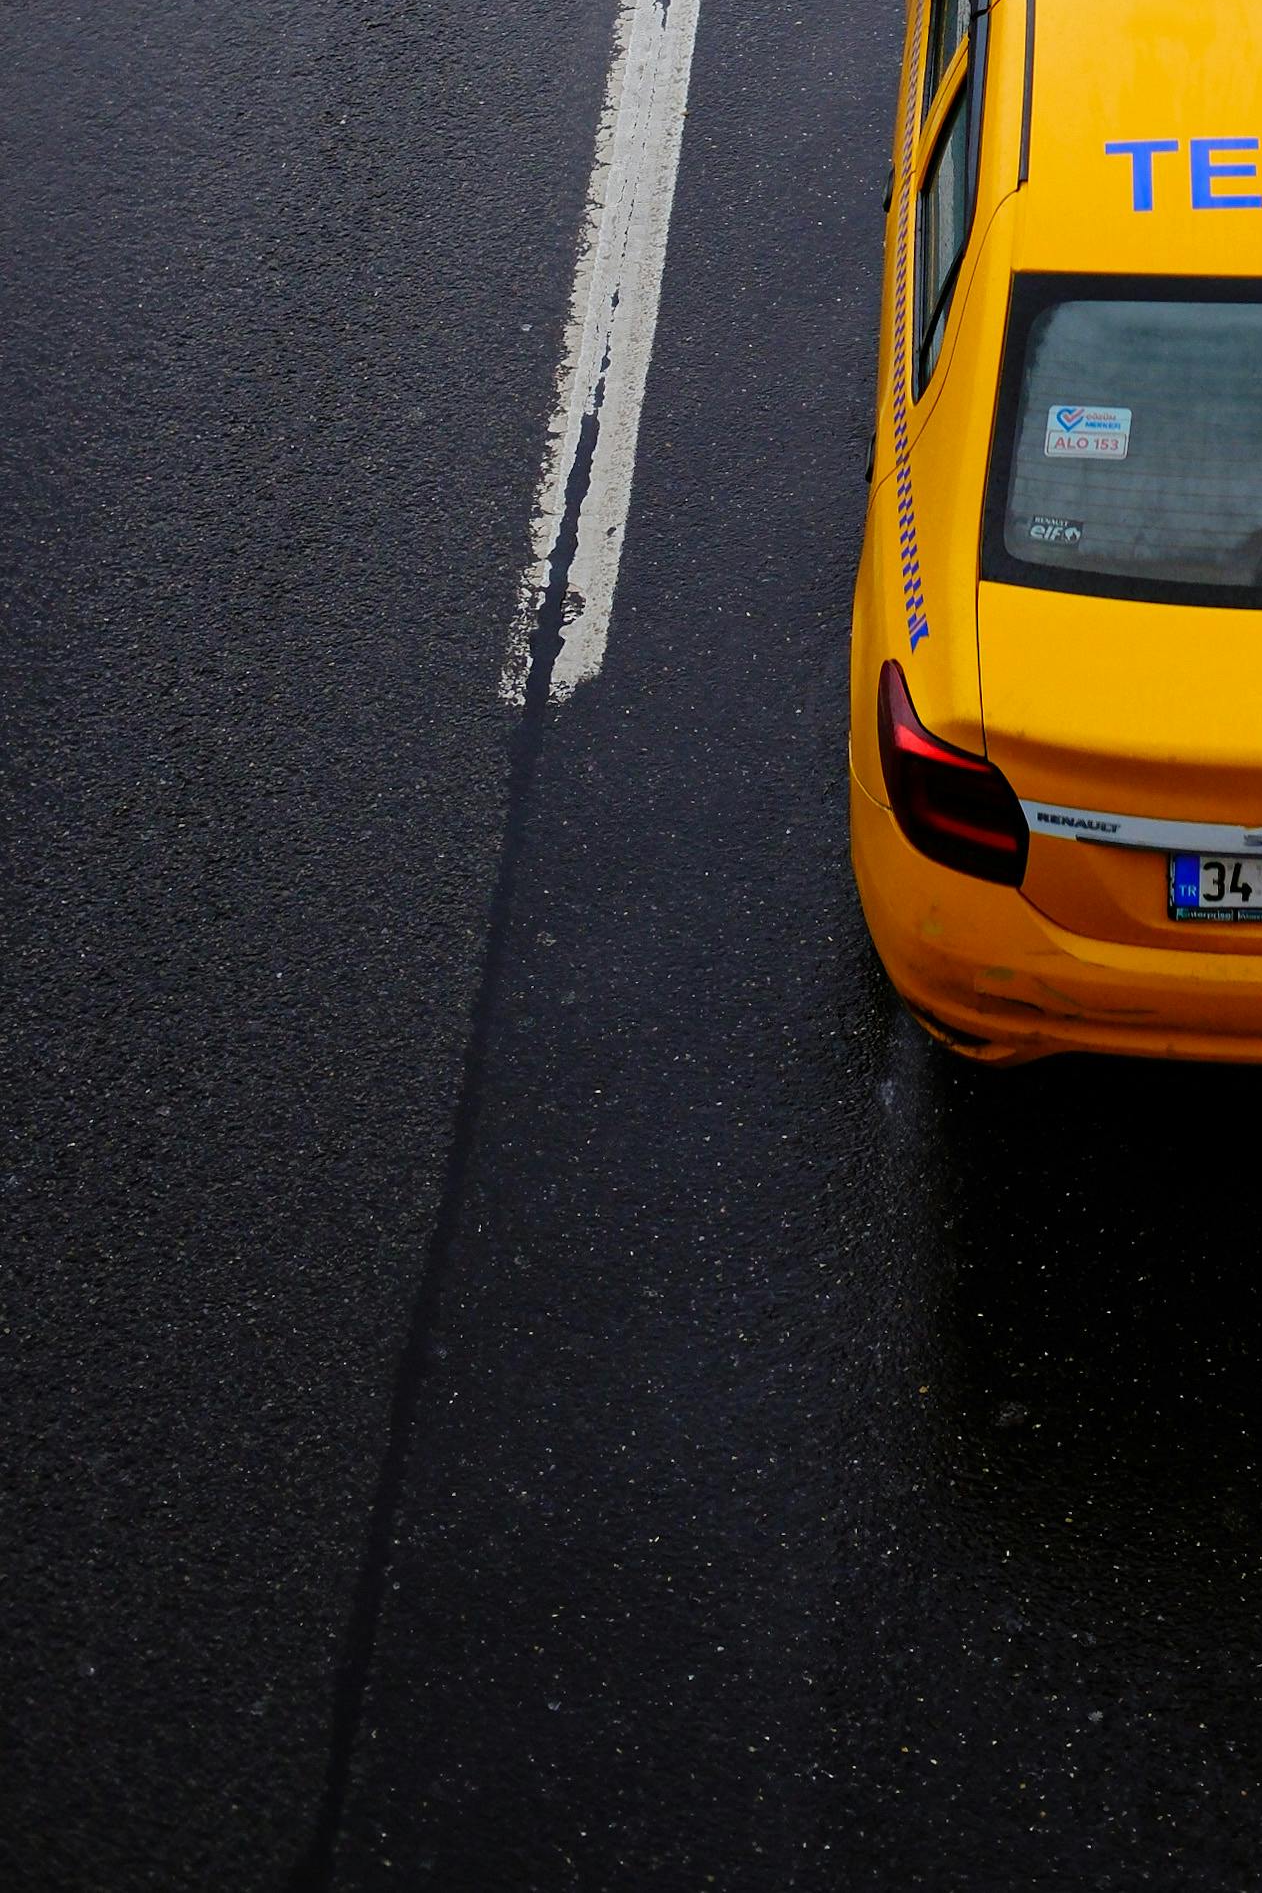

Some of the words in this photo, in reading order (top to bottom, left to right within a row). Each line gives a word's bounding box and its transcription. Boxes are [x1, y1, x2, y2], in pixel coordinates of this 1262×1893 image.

[1055, 437, 1089, 450] ALO
[1094, 438, 1119, 451] 153
[1036, 811, 1121, 834] RENAULT
[1179, 884, 1198, 898] TR
[1202, 861, 1253, 903] 34
